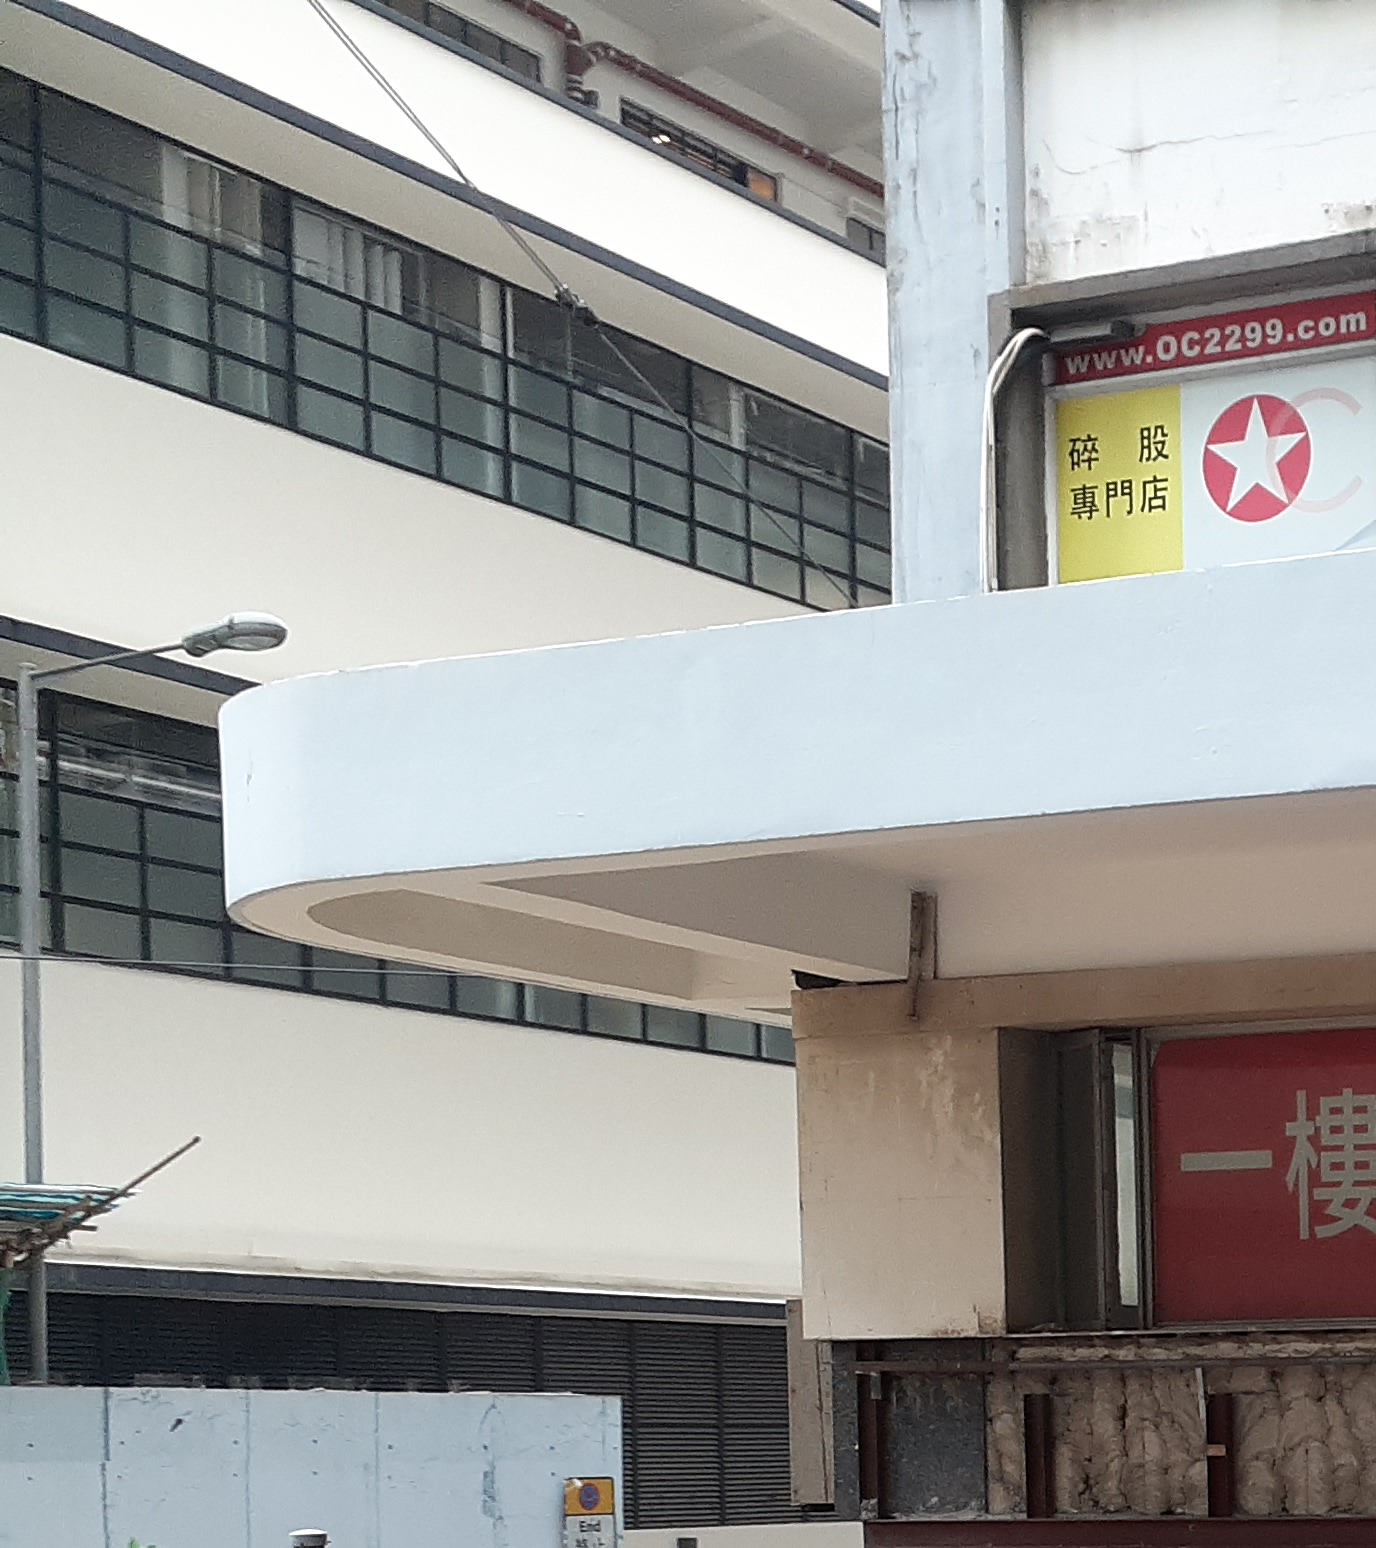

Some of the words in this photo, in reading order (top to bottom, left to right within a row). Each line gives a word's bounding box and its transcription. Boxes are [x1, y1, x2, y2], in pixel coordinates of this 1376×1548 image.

[1065, 311, 1366, 374] www.OC2299.com
[1070, 476, 1169, 520] 專門店
